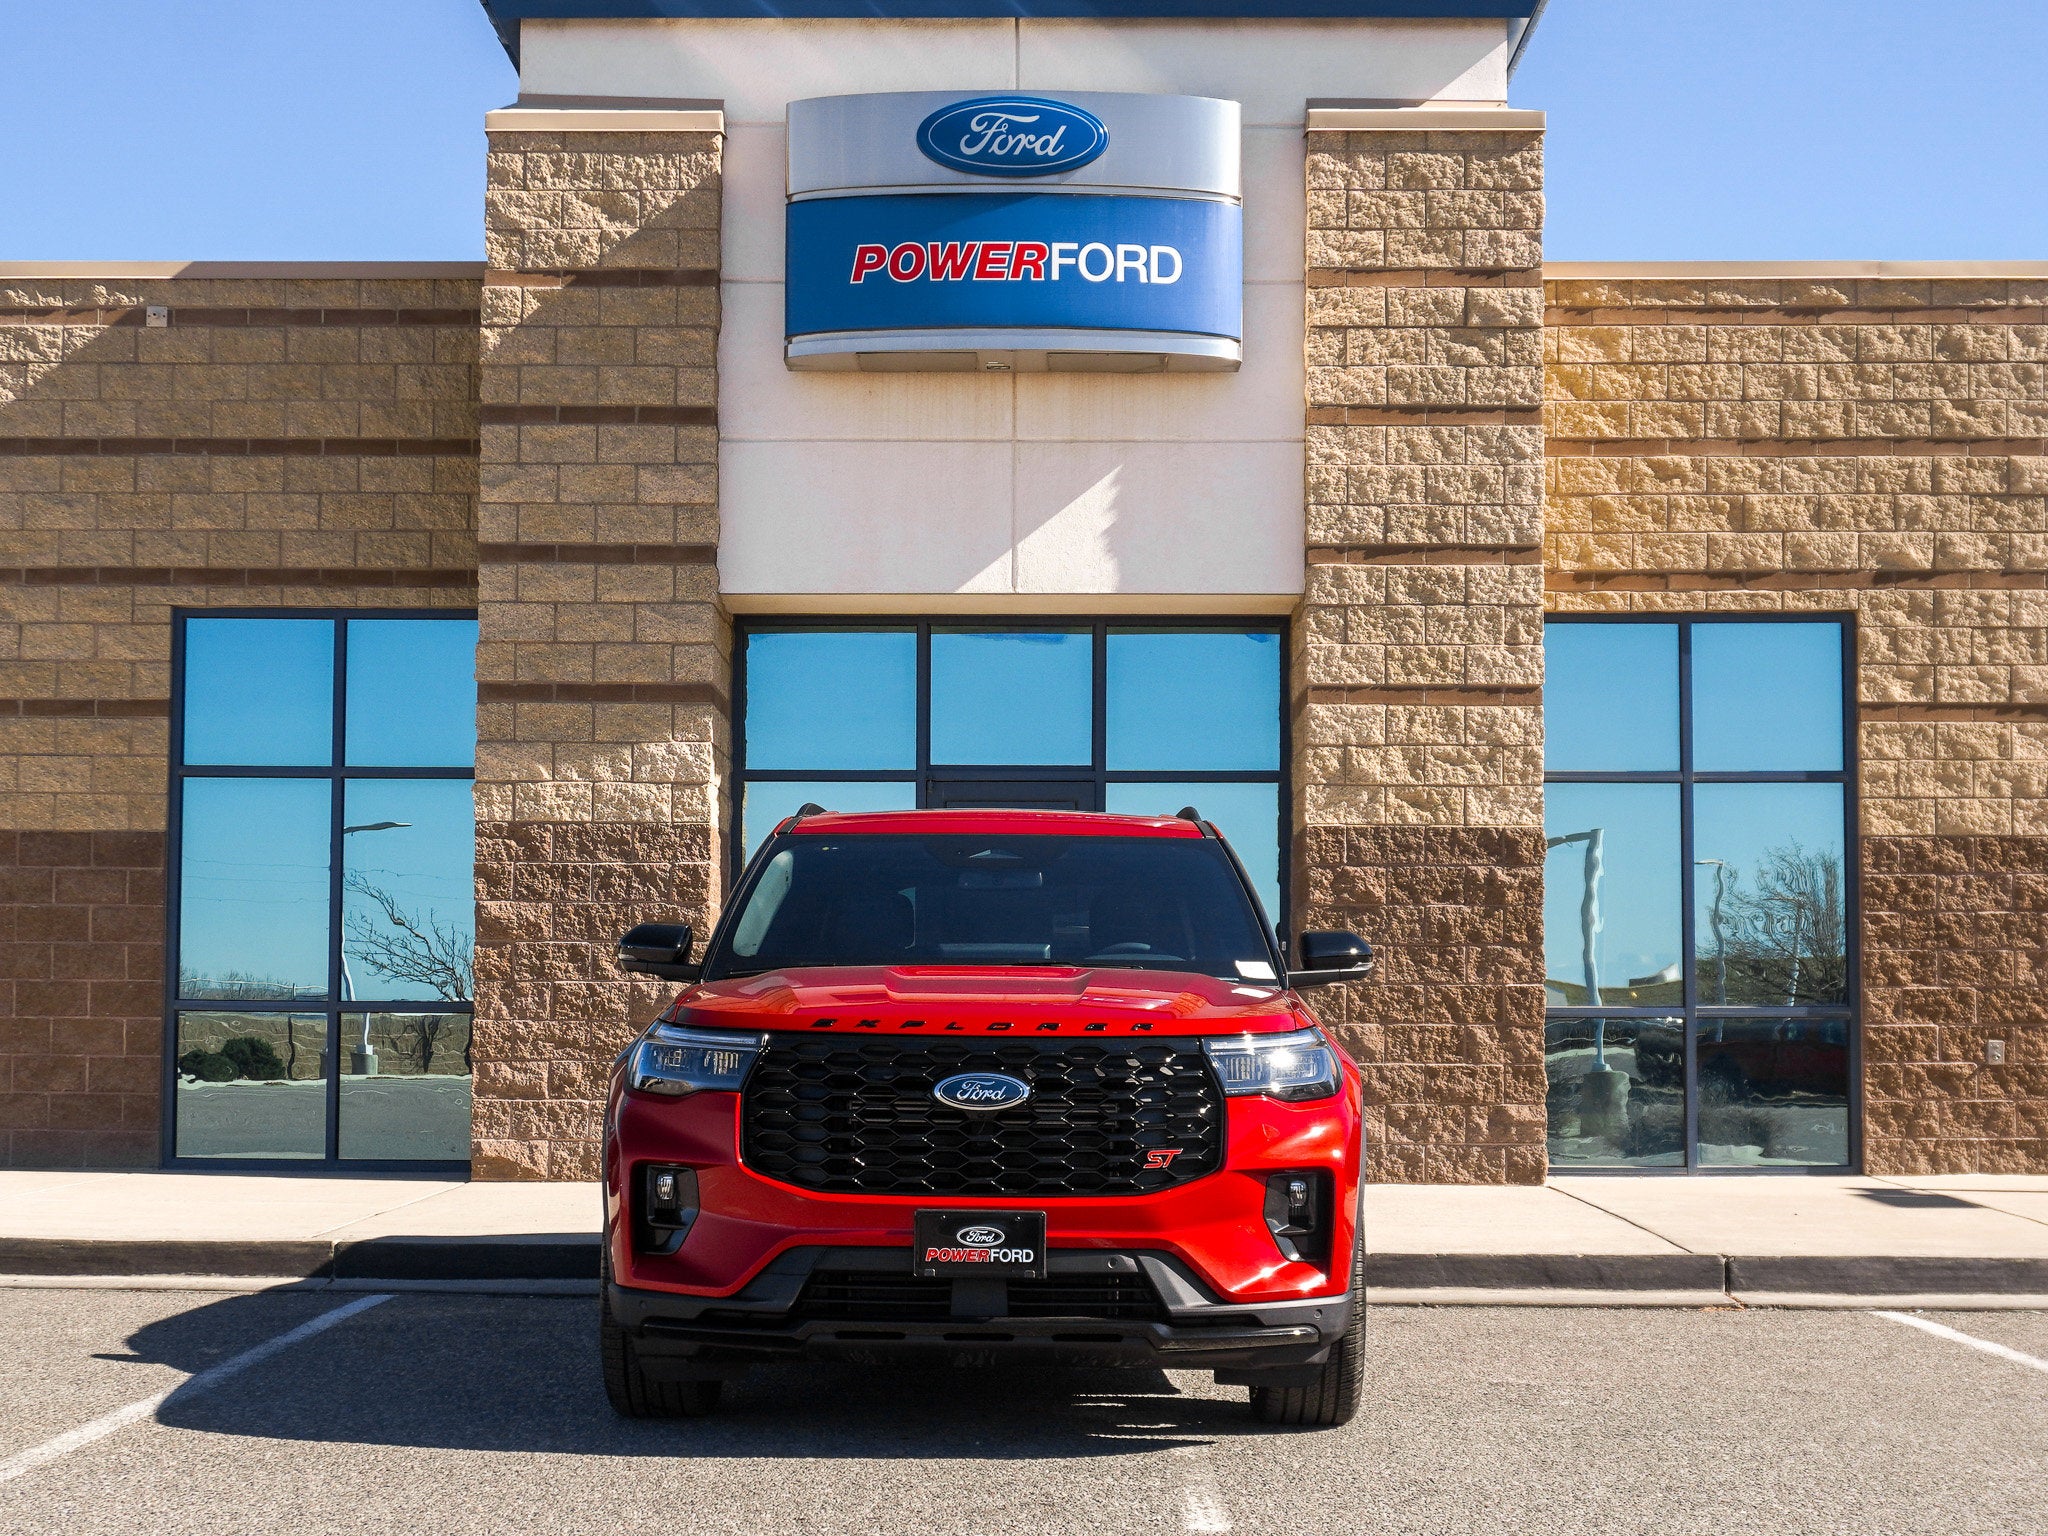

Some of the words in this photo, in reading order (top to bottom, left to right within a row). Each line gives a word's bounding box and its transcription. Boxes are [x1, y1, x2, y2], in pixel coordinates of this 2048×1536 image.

[959, 111, 1067, 157] Ford
[810, 1018, 1154, 1031] EXPLORER
[956, 1080, 1007, 1101] Ford
[1143, 1148, 1184, 1169] ST
[966, 1230, 995, 1243] Ford
